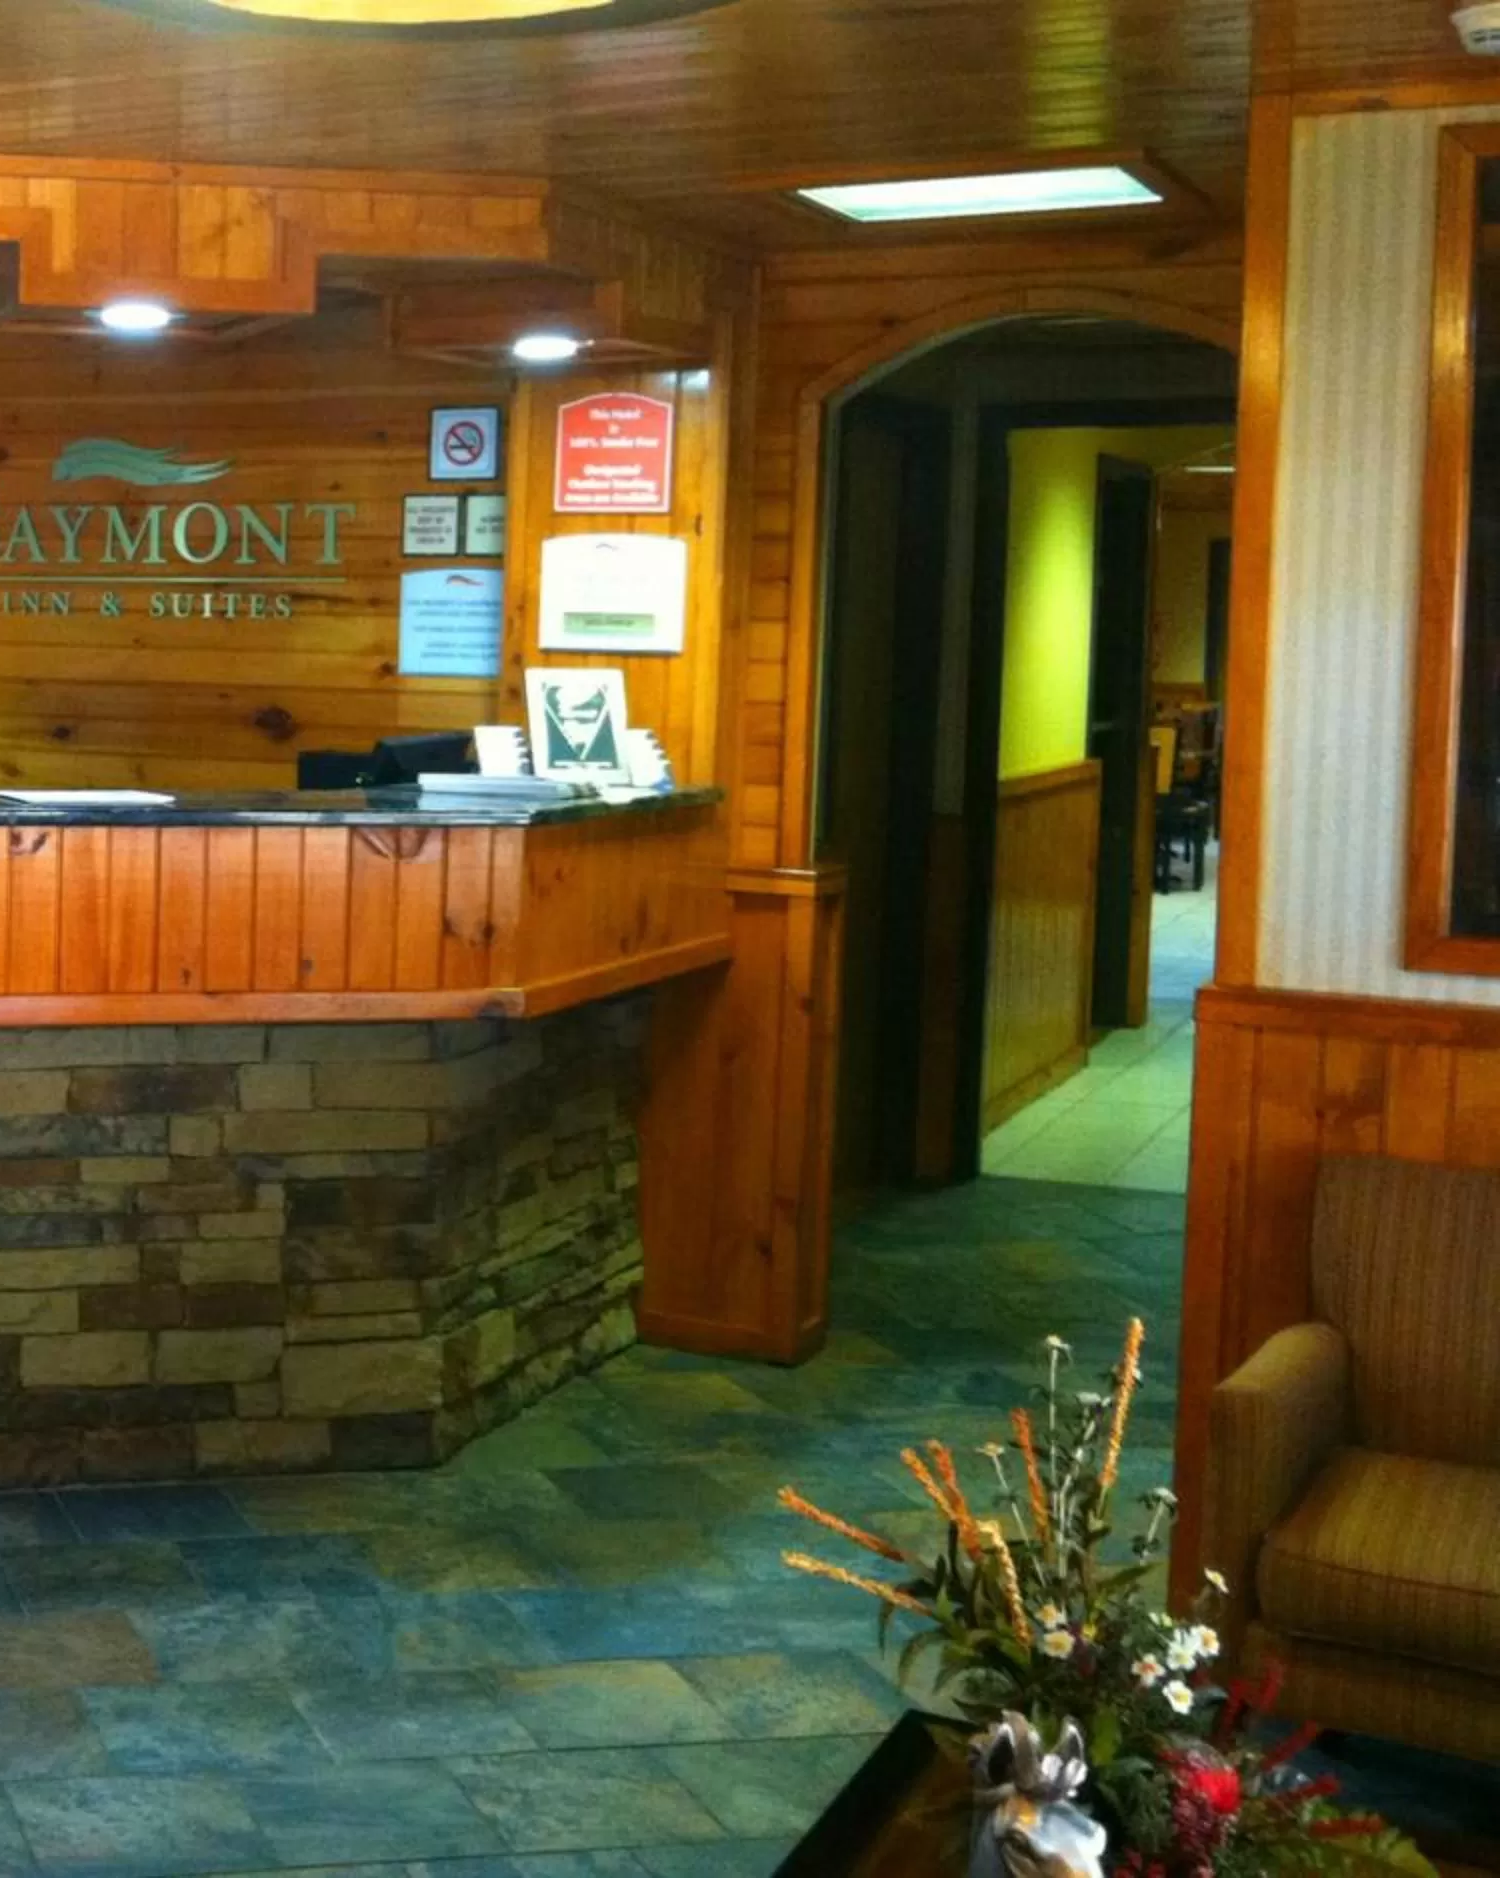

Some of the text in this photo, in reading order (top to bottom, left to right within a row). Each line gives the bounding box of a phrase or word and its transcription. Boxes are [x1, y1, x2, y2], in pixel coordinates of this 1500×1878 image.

[3, 592, 293, 618] INN & SUITES
